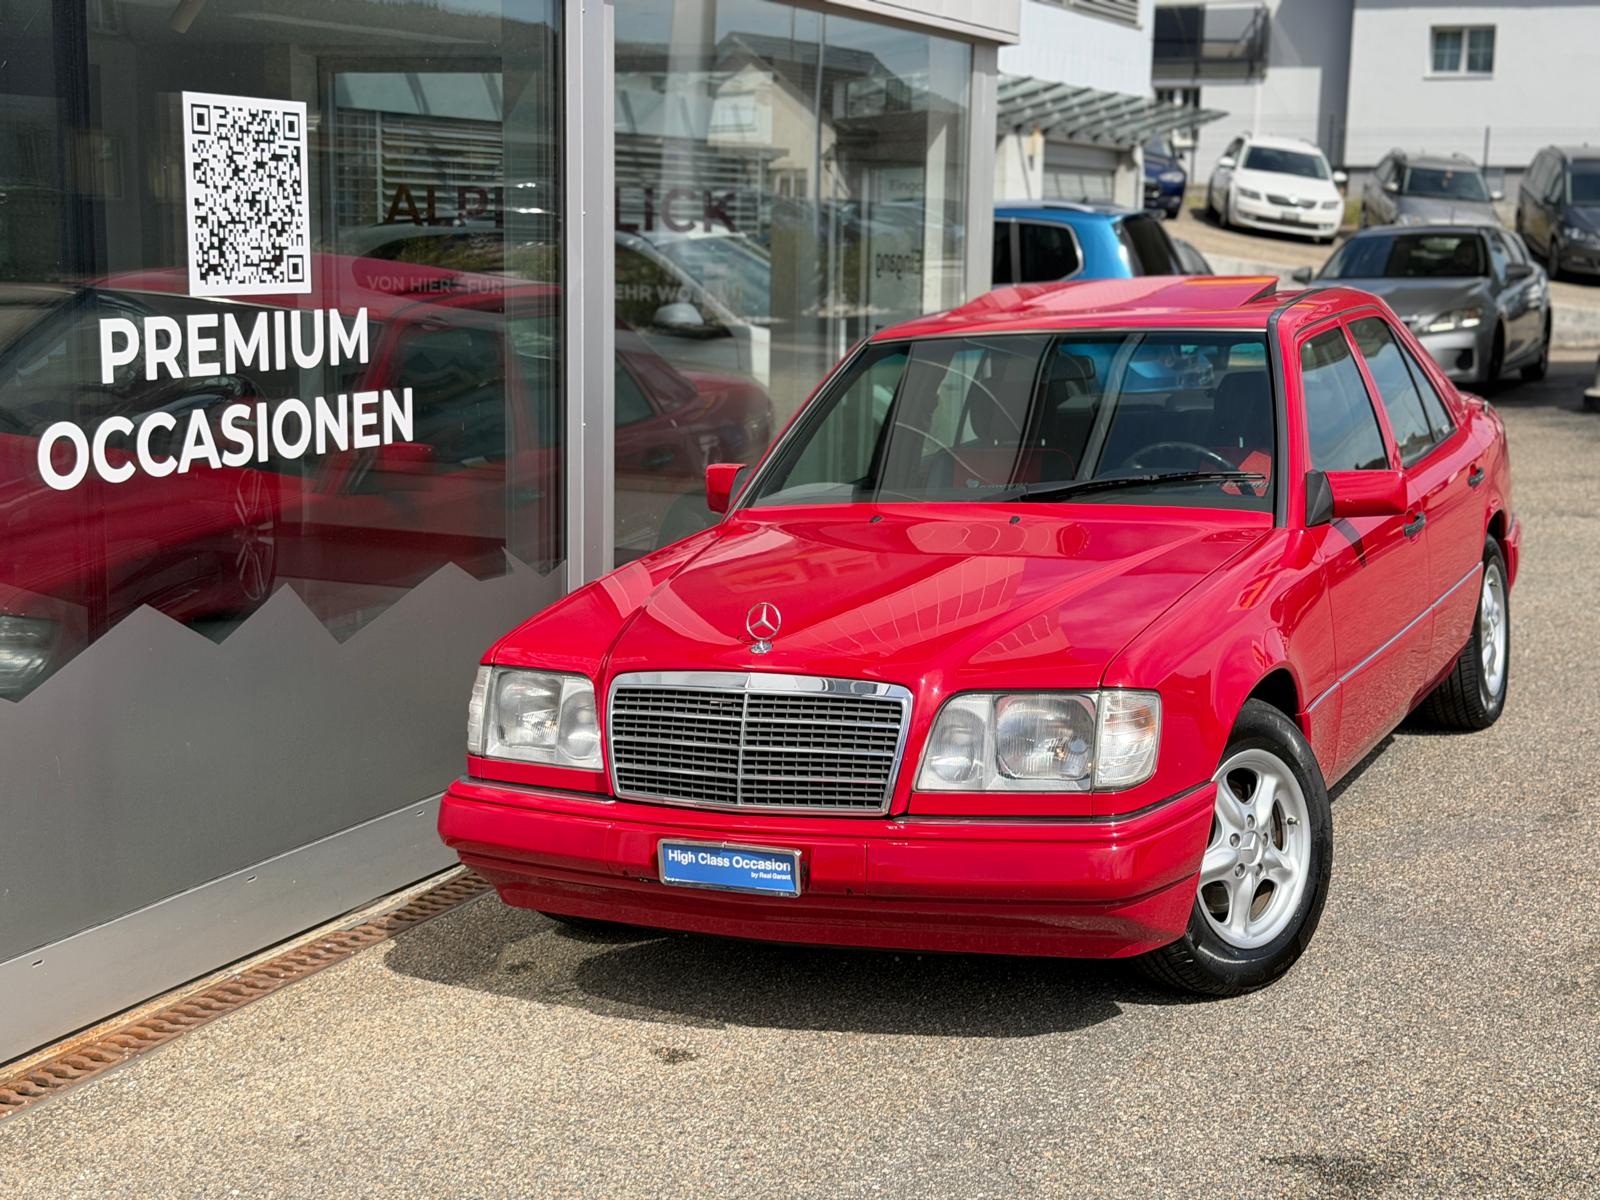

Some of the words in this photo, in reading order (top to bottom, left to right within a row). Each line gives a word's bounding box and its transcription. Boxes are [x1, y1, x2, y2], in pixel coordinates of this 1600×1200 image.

[367, 275, 404, 291] VON
[411, 278, 450, 294] HIER
[615, 284, 651, 300] EHR
[99, 307, 369, 384] PREMIUM
[37, 387, 413, 491] OCCASIONEN
[668, 849, 696, 865] High
[698, 853, 730, 867] Class
[732, 856, 791, 872] Occasion
